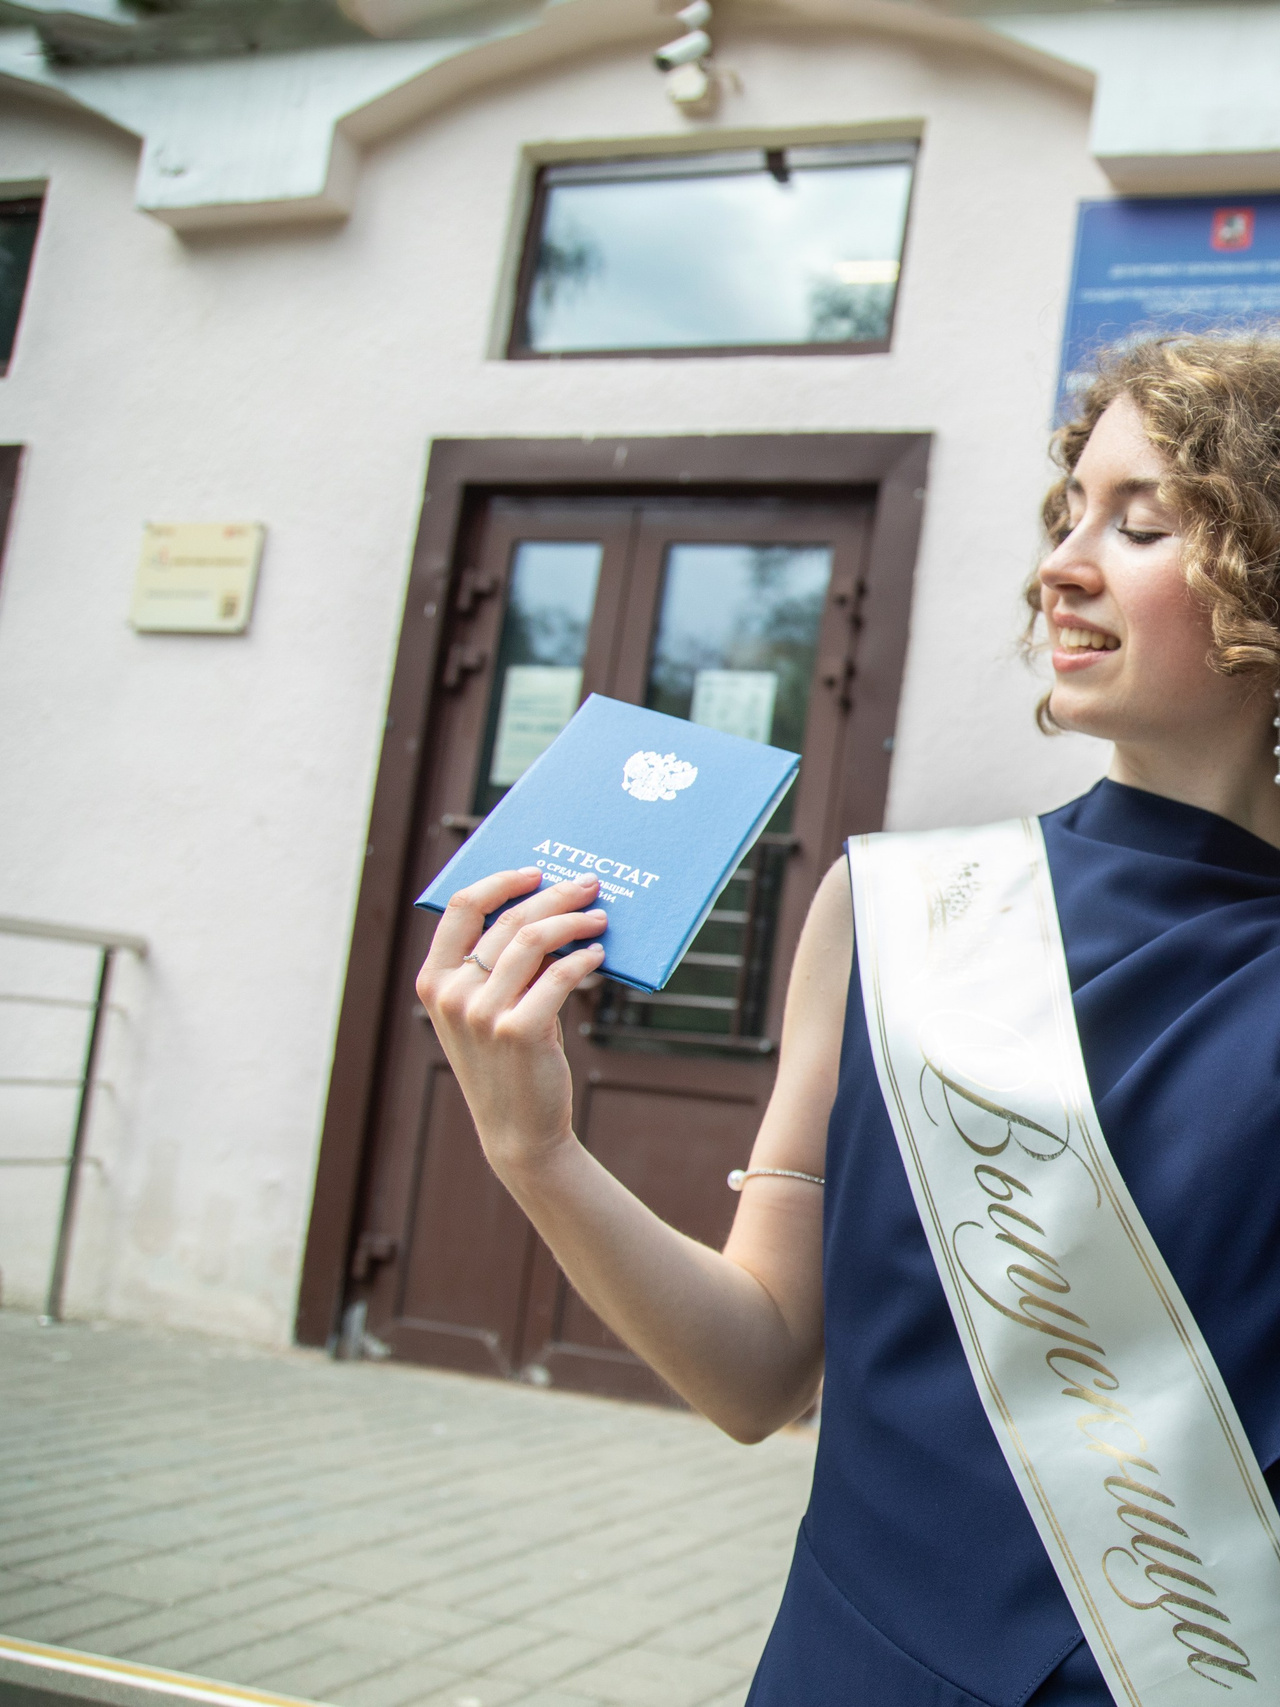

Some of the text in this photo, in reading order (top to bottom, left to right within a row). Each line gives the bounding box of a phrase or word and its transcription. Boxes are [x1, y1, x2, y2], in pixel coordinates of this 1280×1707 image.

[532, 839, 660, 889] АТТЕСТАТ
[536, 859, 546, 868] О
[546, 862, 585, 881] СРЕДН
[918, 1009, 1258, 1690] Выпускница
